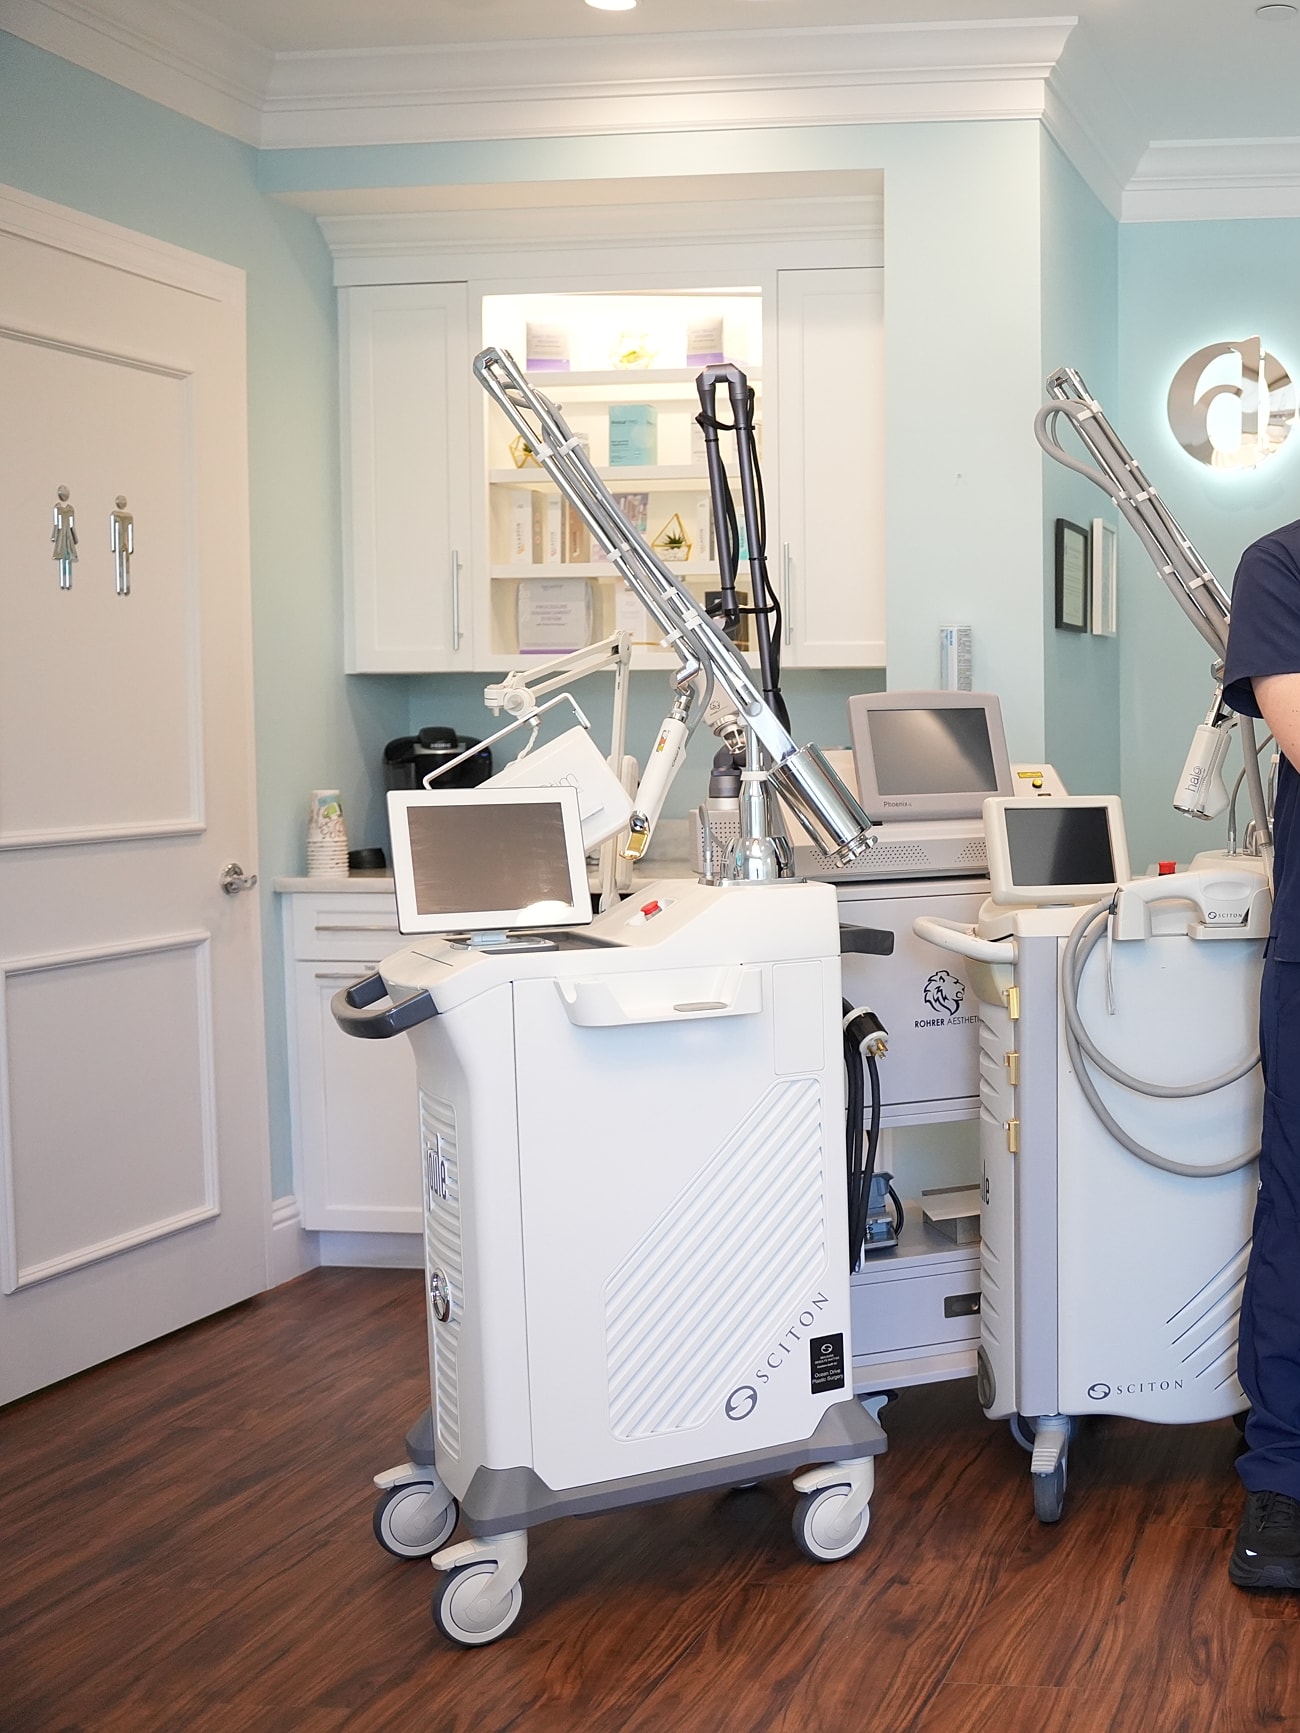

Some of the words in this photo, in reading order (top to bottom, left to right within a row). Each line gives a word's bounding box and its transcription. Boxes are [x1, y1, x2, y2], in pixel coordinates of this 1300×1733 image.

[914, 1018, 945, 1029] ROHRER
[755, 1291, 829, 1384] SCITON
[1116, 1379, 1184, 1395] SCITON
